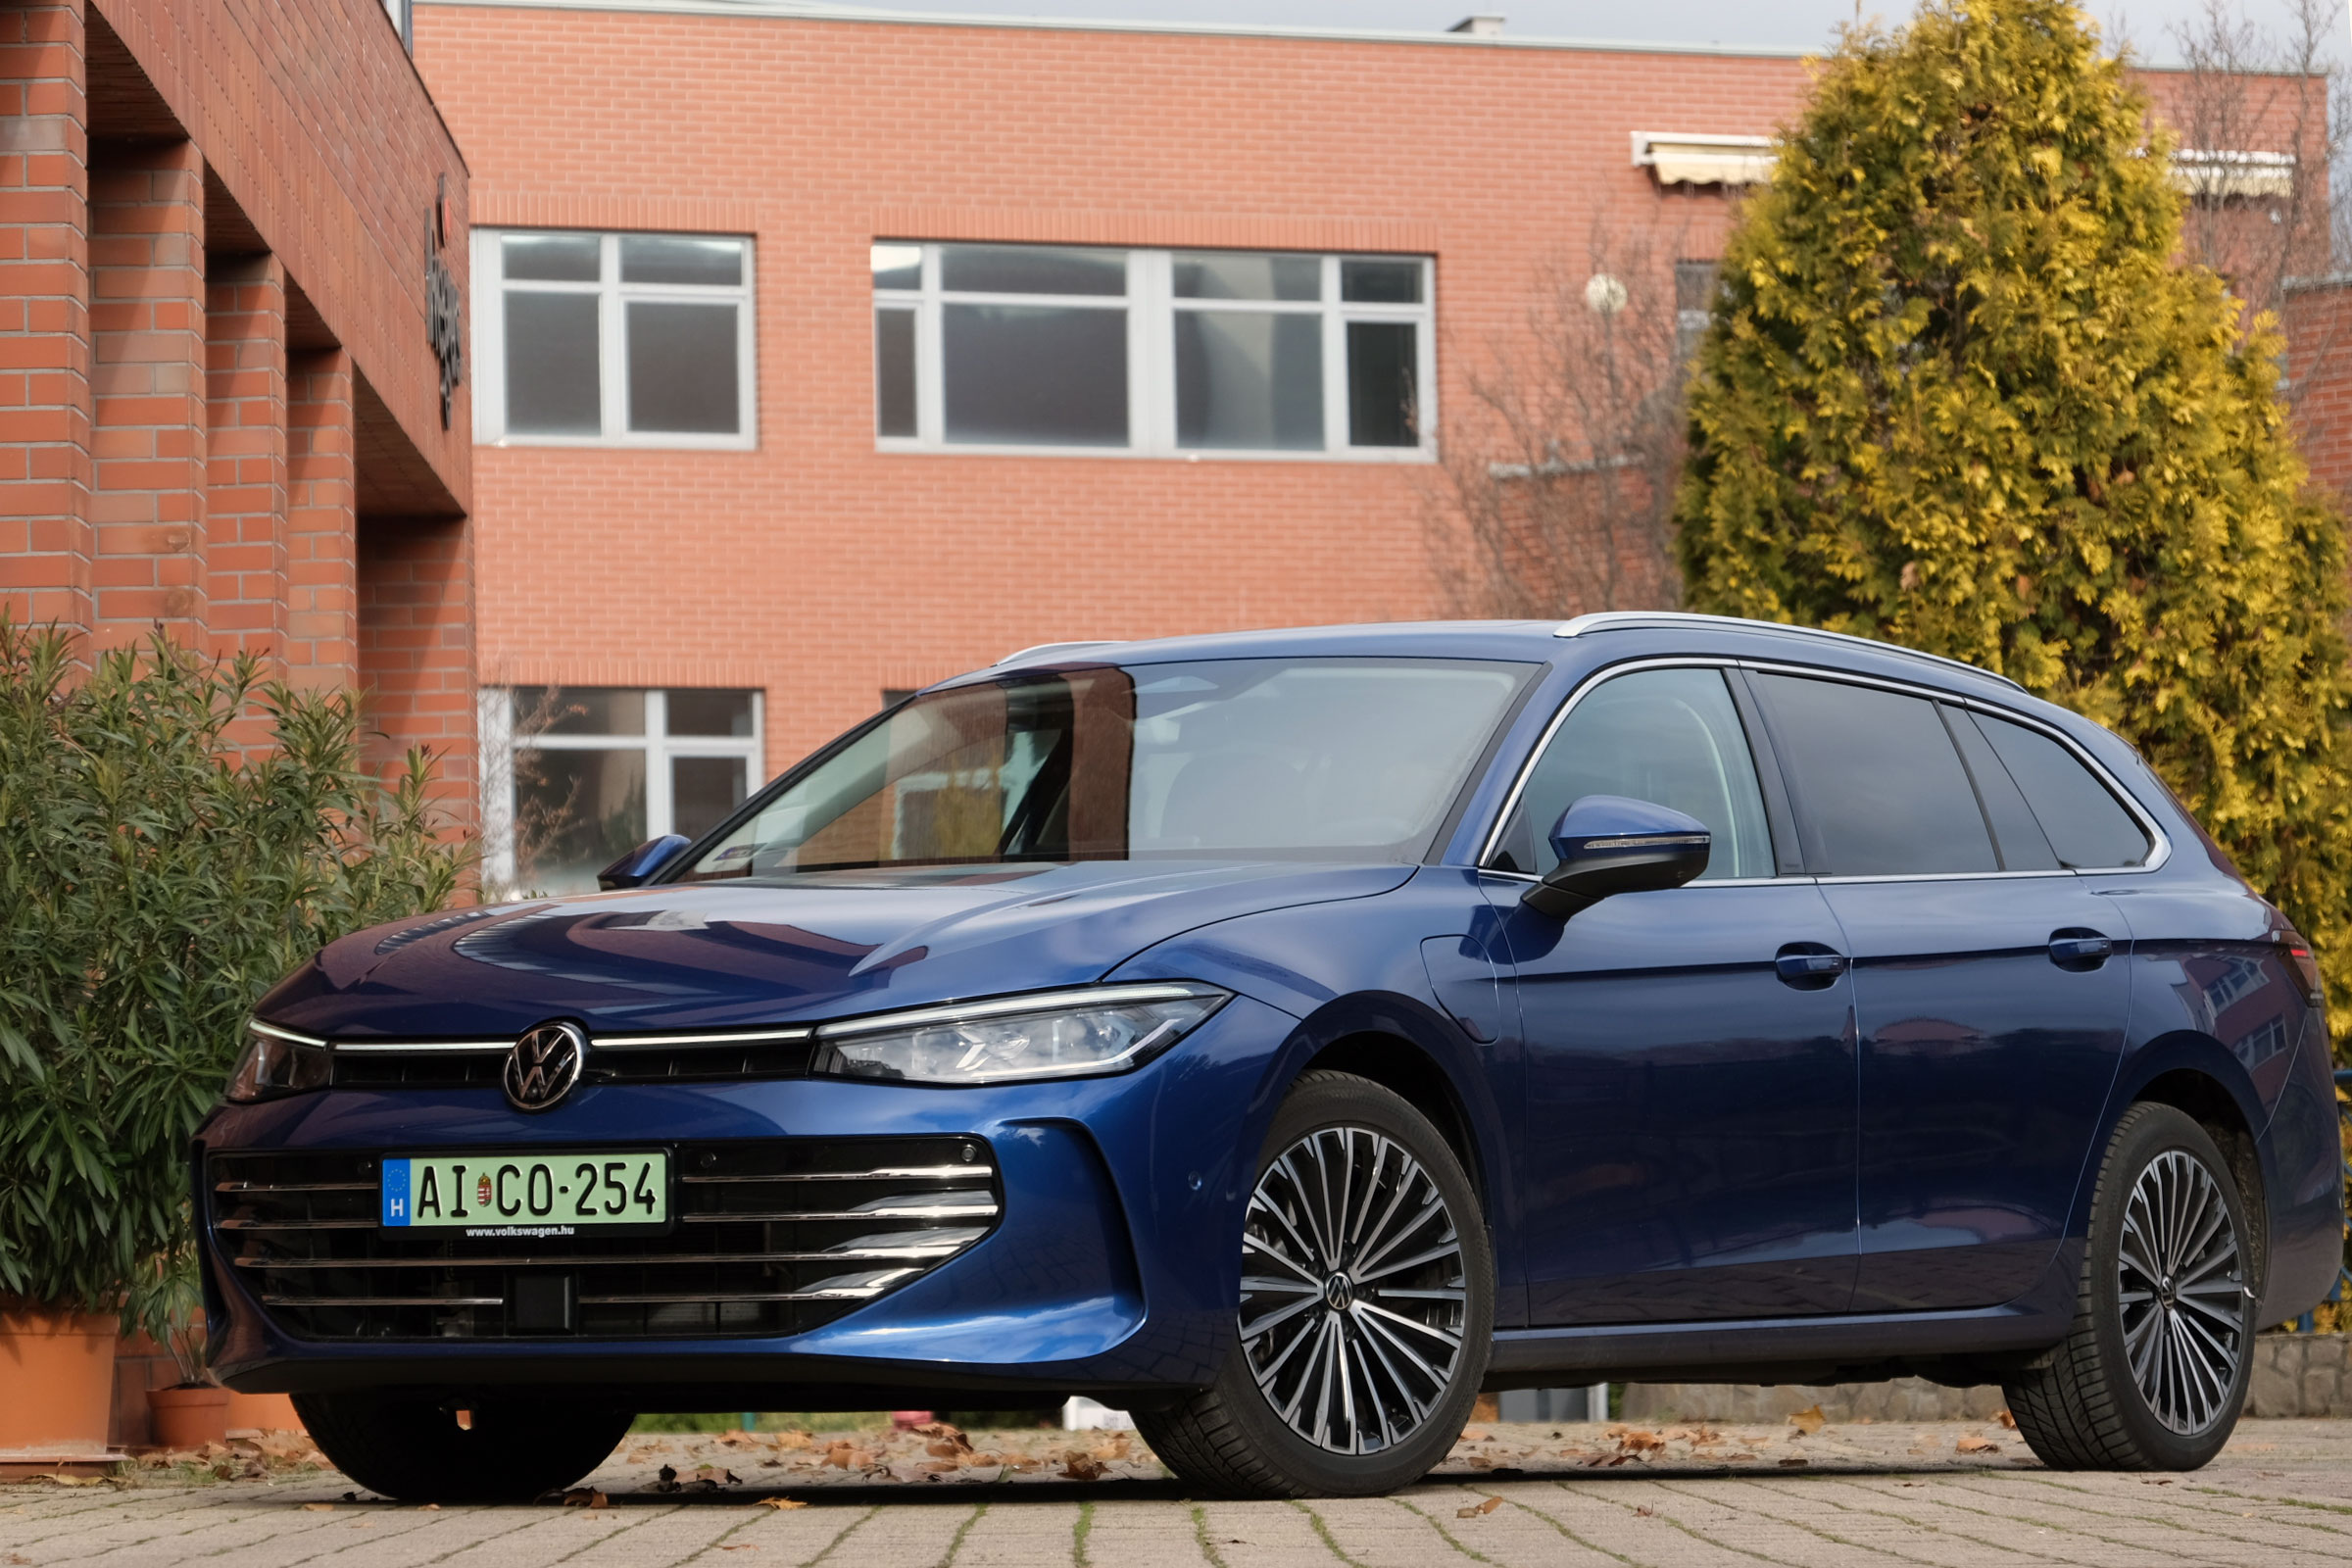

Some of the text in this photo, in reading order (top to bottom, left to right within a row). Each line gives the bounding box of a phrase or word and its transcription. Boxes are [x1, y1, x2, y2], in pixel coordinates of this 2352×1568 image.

[505, 1027, 580, 1107] VW
[390, 1198, 404, 1217] H
[417, 1165, 468, 1218] AI
[466, 1225, 575, 1238] www.volkswagen.hu
